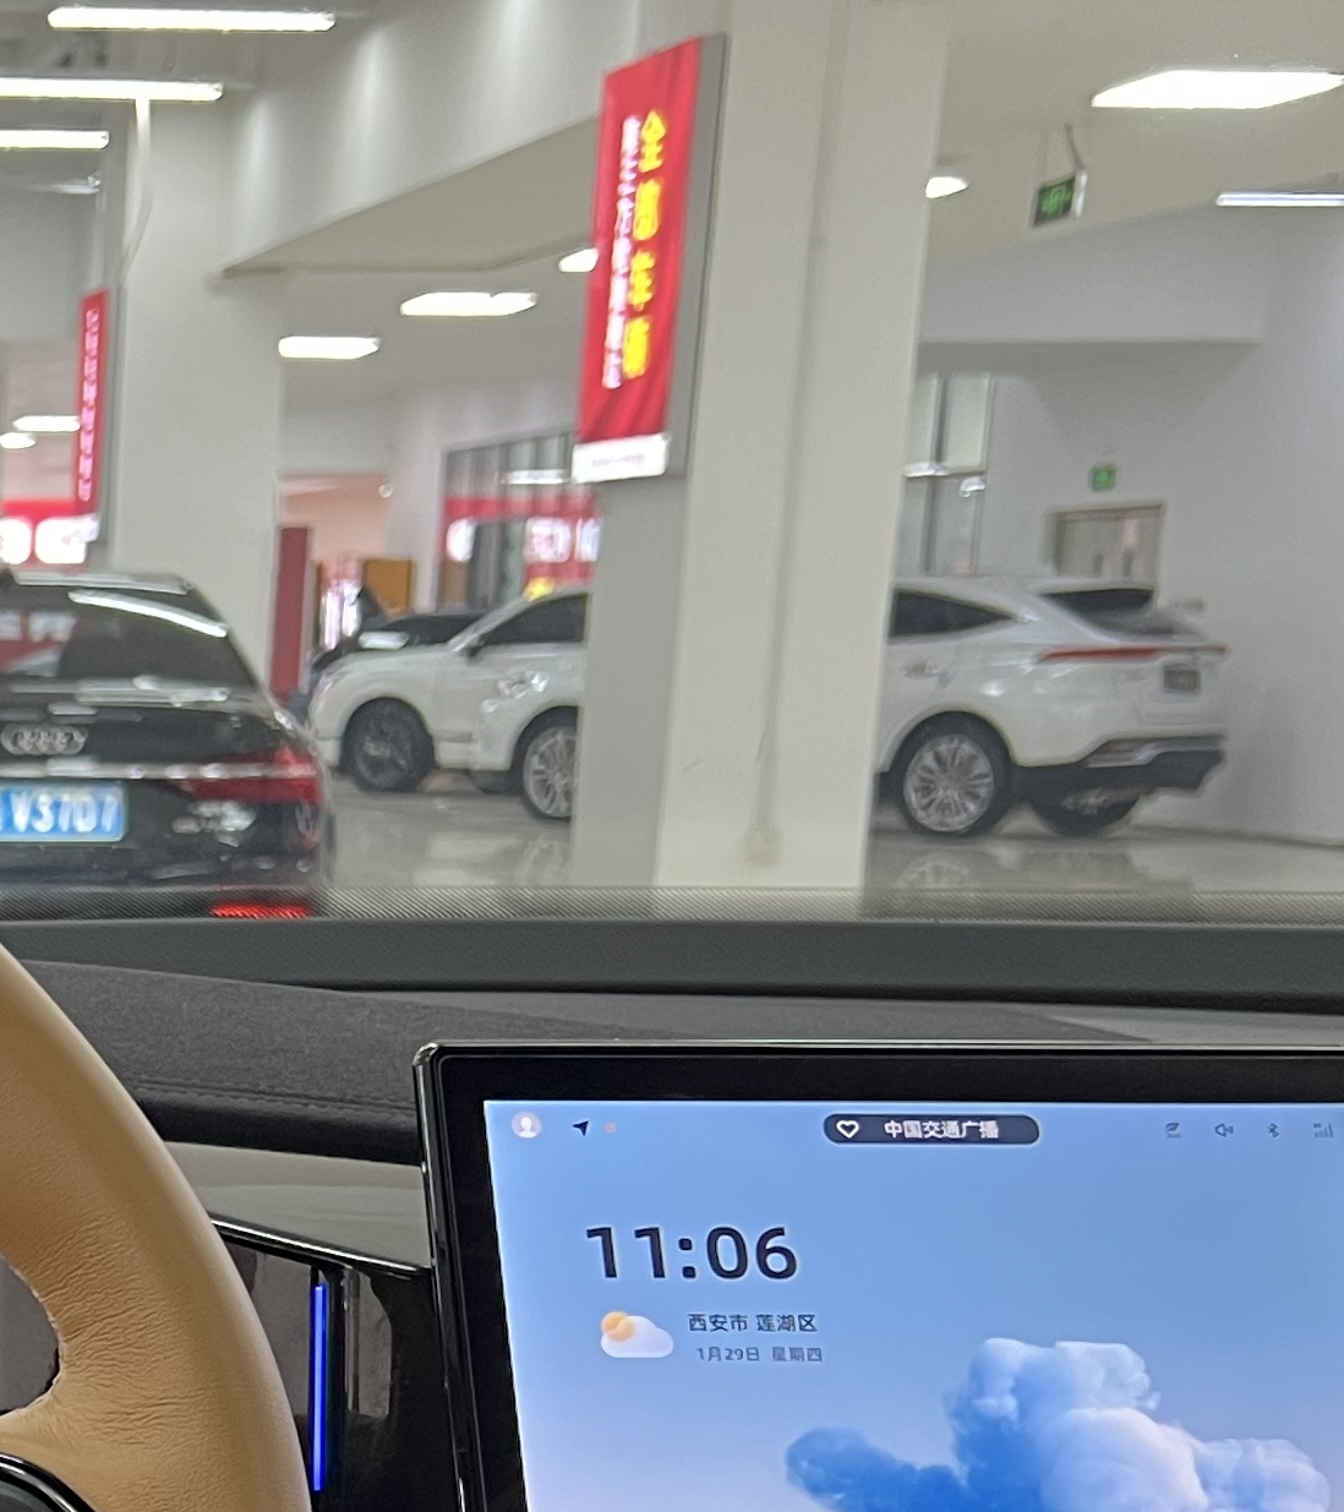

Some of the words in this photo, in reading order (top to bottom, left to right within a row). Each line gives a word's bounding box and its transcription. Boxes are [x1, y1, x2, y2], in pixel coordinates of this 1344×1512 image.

[884, 1119, 999, 1139] 中国交通广播
[586, 1225, 798, 1280] 11:06
[688, 1312, 748, 1332] 西安市
[757, 1312, 817, 1332] 莲湖区
[697, 1346, 760, 1362] 1月29日
[772, 1346, 823, 1362] 星期四
